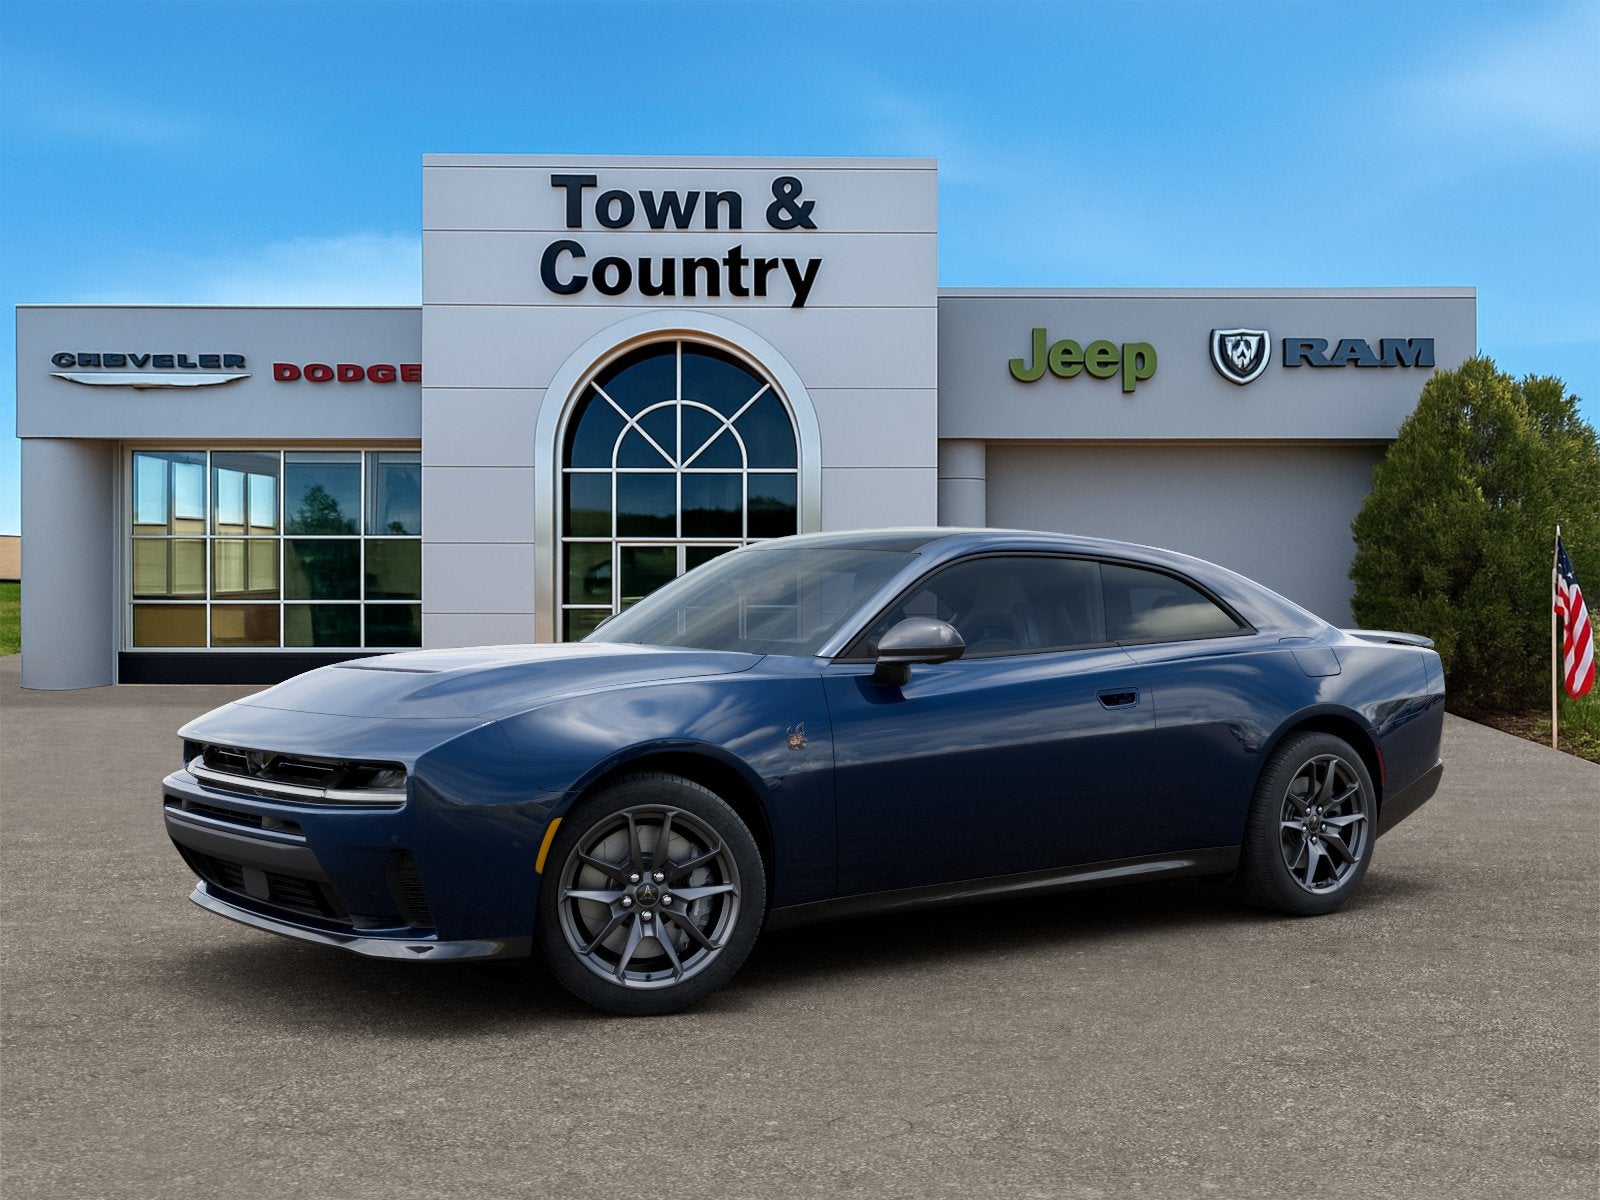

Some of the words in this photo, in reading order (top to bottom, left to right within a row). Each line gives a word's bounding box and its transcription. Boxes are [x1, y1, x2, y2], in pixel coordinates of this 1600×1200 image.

[551, 174, 742, 229] Town
[765, 176, 818, 230] &
[540, 239, 823, 308] Country
[273, 363, 422, 383] DODGE
[1009, 328, 1157, 393] Jeep
[1282, 338, 1435, 367] RAM
